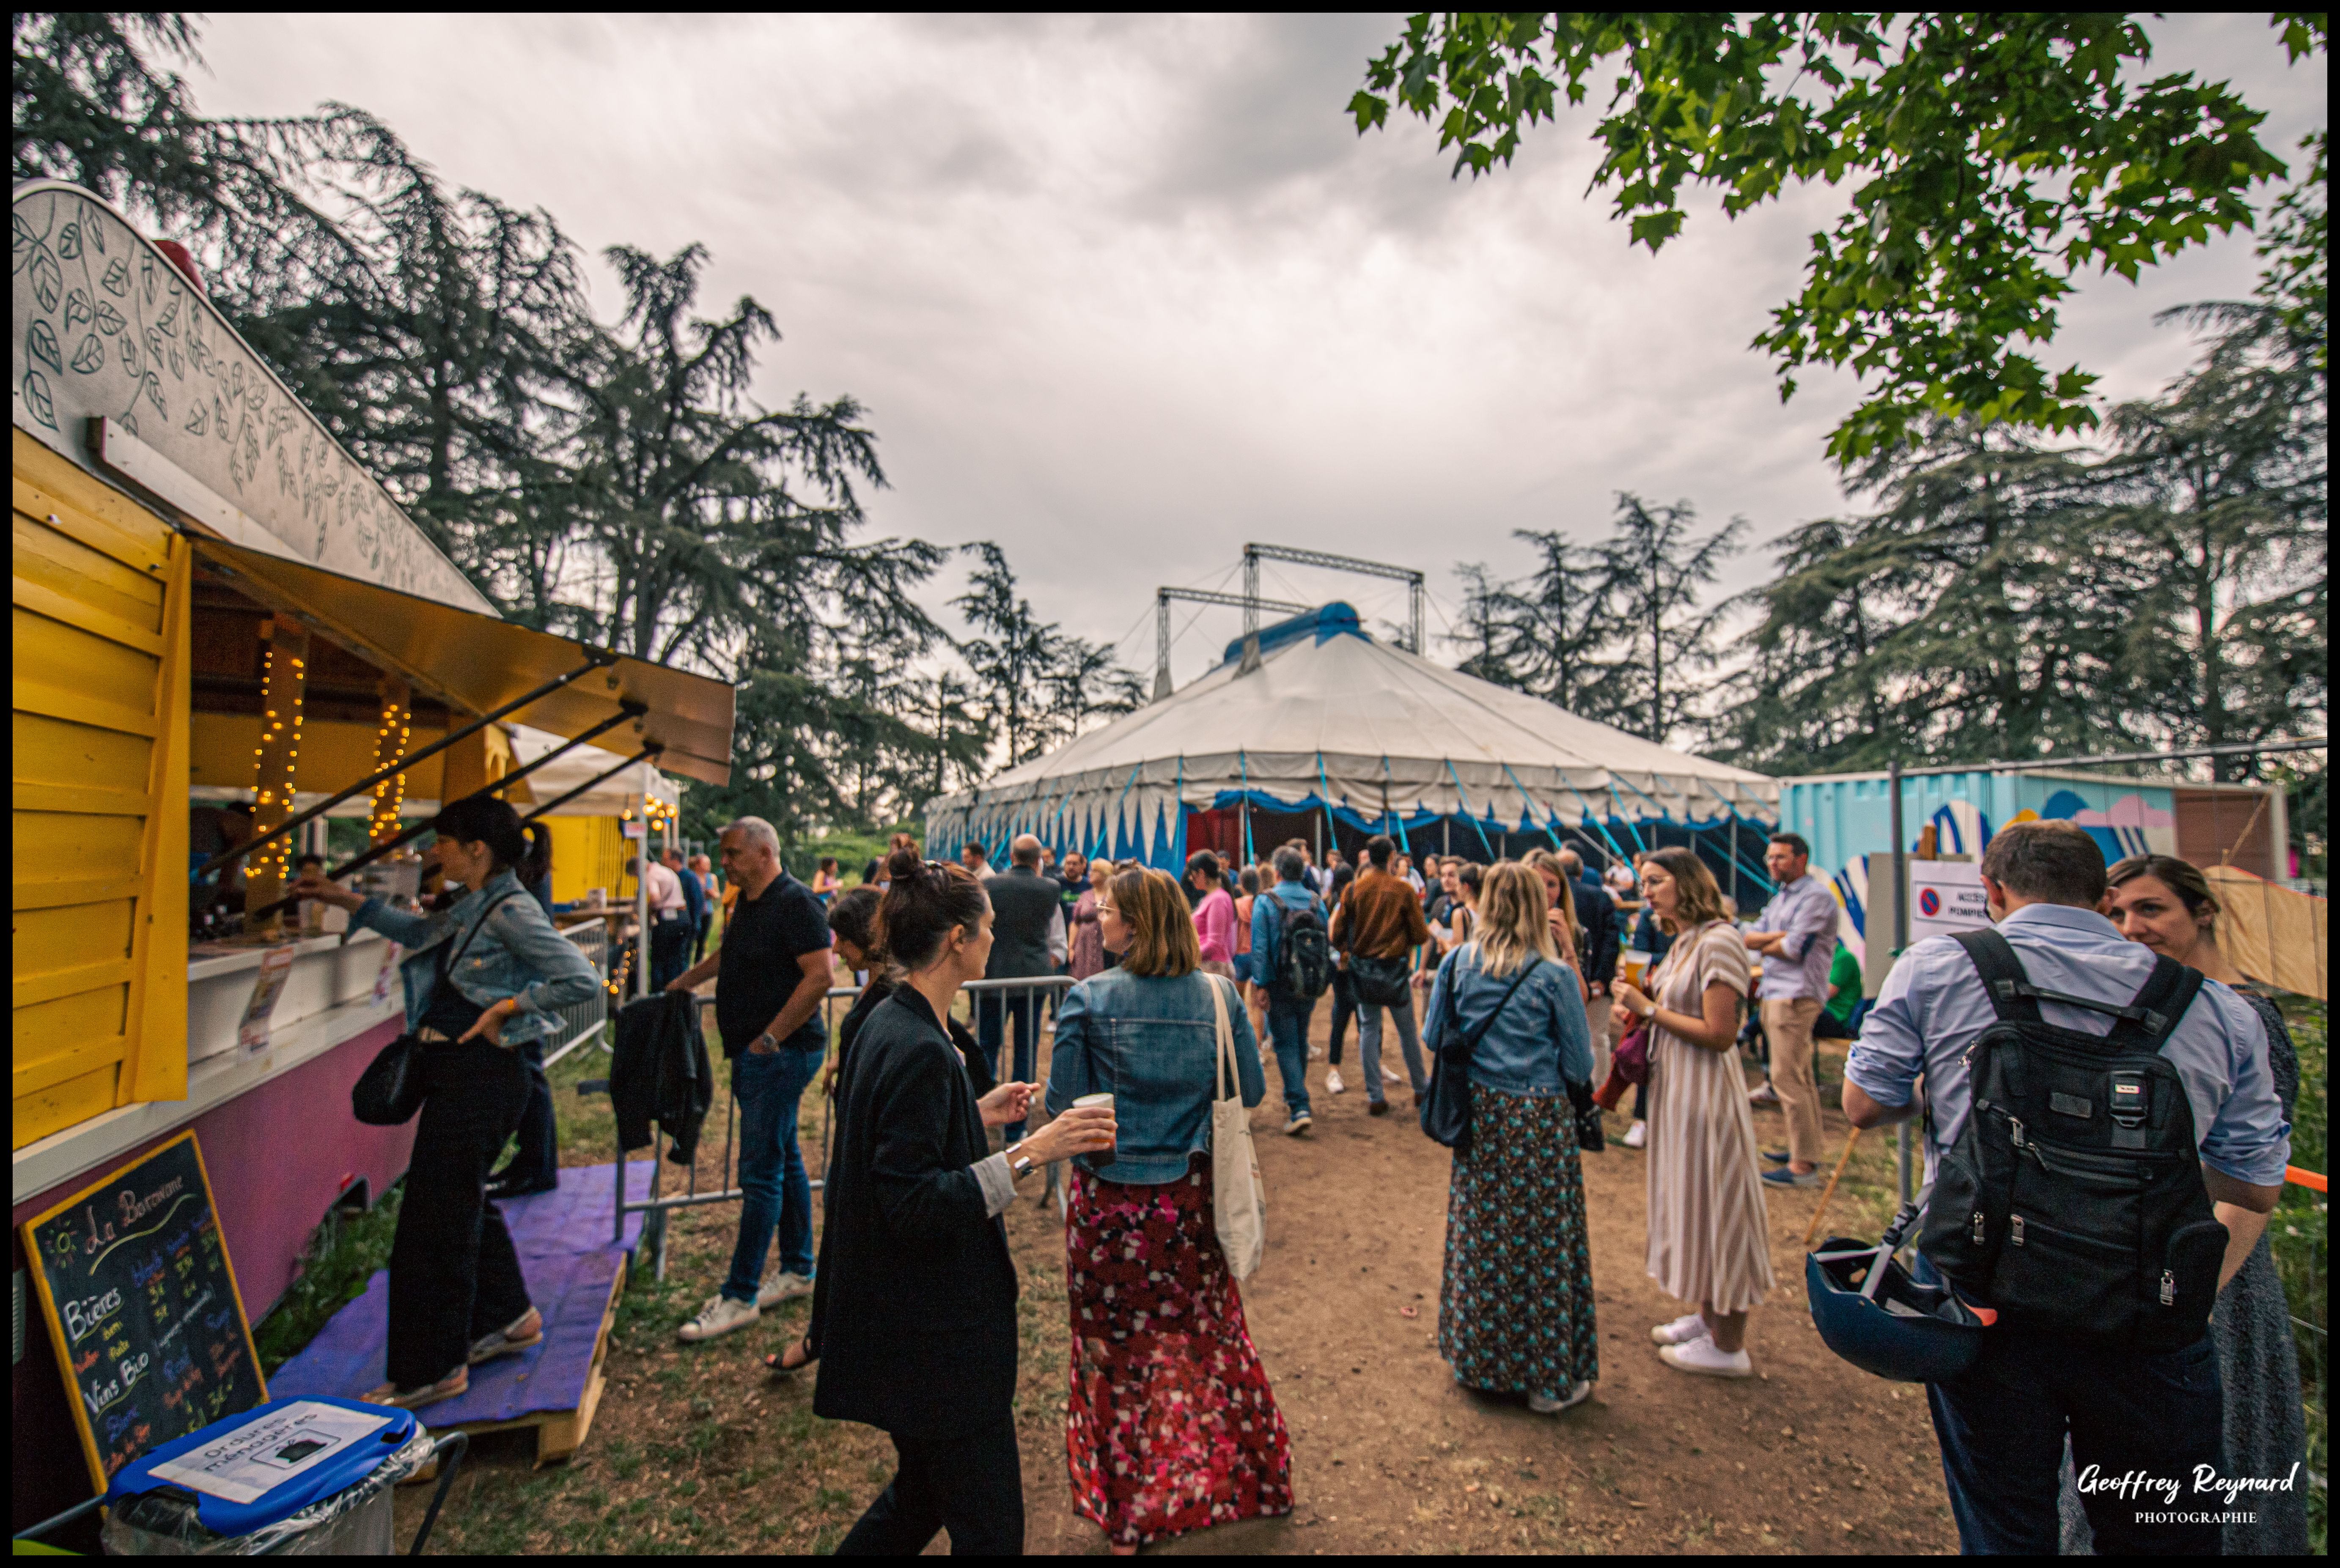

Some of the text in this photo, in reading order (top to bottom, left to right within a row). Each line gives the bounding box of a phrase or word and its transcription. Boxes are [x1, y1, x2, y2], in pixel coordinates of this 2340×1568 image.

[84, 1205, 116, 1255] La
[63, 1287, 121, 1342] Bières
[83, 1379, 120, 1414] Vins
[120, 1352, 149, 1387] Bio
[204, 1417, 287, 1458] Ordures
[204, 1414, 317, 1472] ménagères
